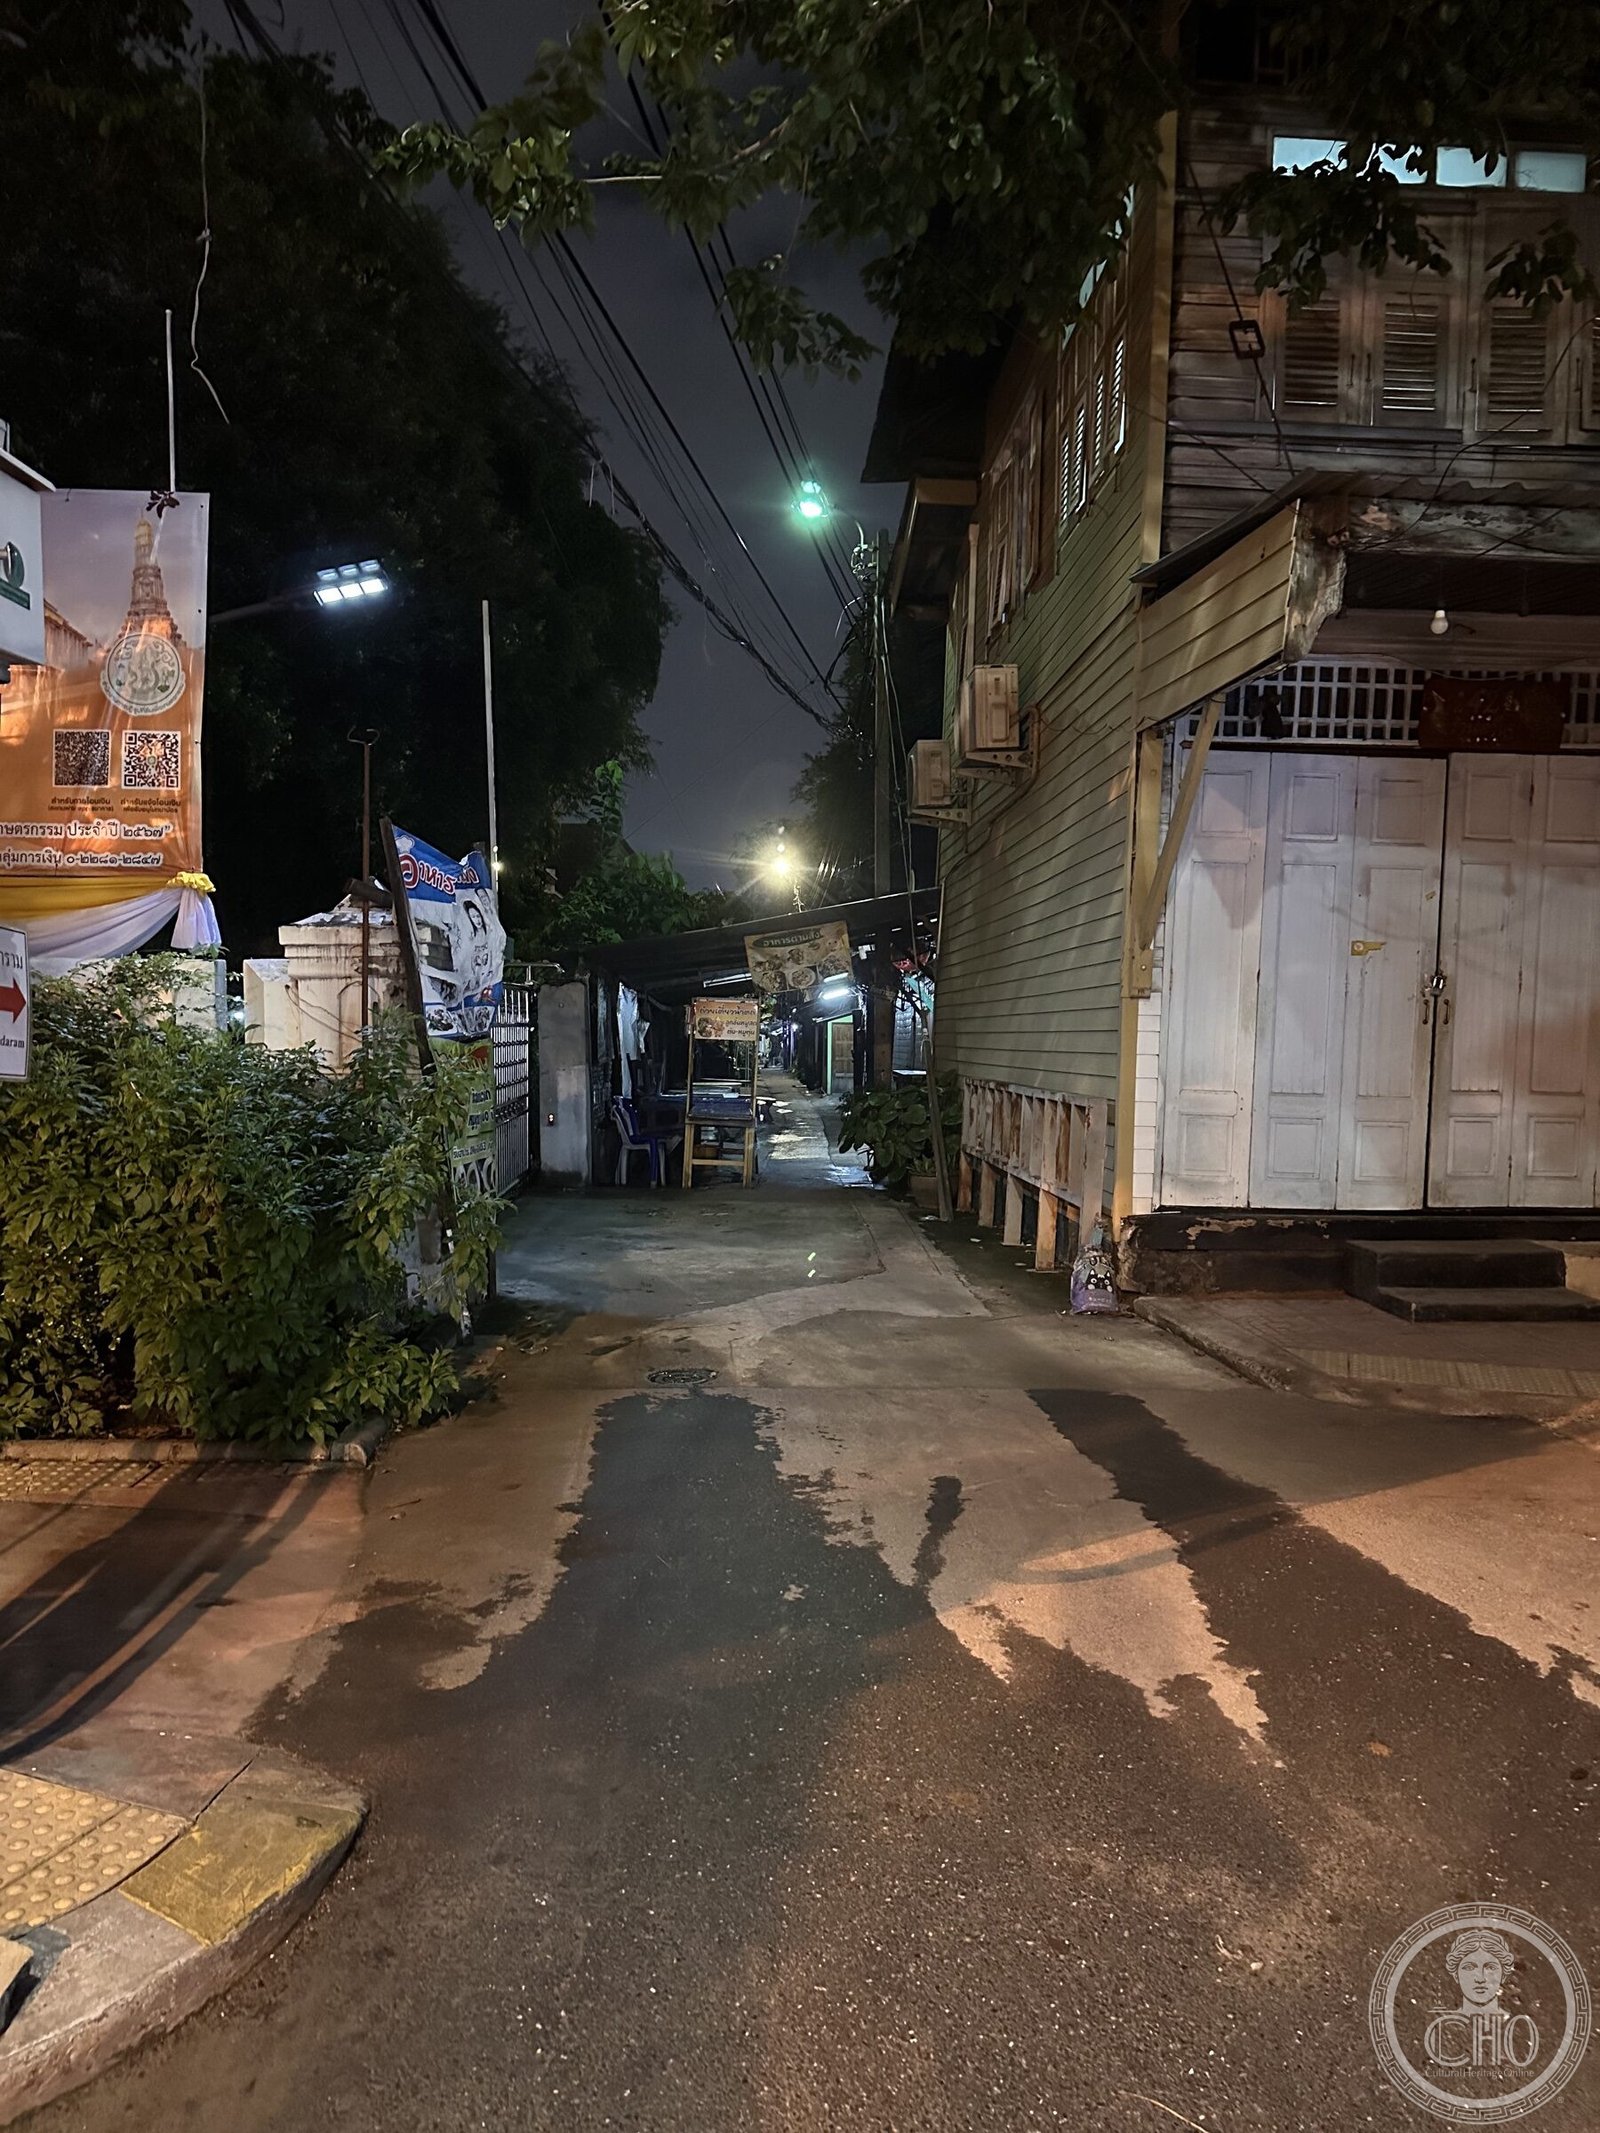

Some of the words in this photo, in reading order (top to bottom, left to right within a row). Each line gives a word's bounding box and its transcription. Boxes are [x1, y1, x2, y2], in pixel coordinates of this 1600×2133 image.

[67, 821, 118, 837] ประจำปี
[0, 849, 62, 867] ลุ่มการเงิน
[0, 1035, 25, 1048] daram
